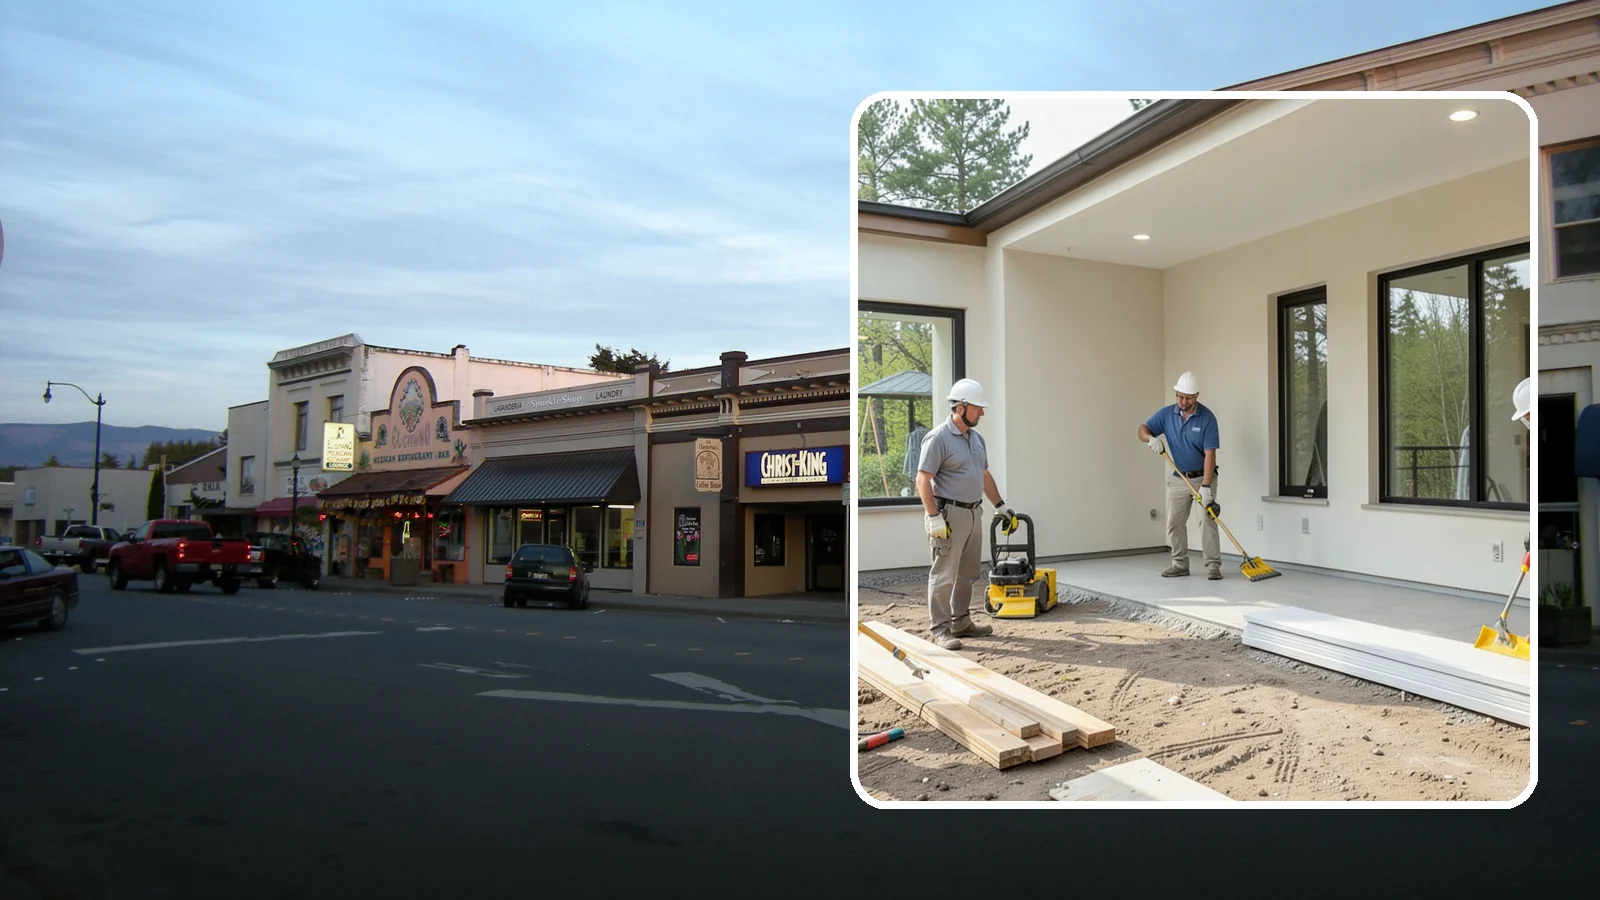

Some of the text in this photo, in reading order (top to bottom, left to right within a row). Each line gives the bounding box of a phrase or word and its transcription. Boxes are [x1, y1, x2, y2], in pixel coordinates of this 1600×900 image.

[595, 389, 624, 400] LAUNDRY
[530, 394, 582, 409] Sparkle Shop
[493, 402, 522, 413] LAVANDERIA
[327, 449, 352, 457] MEXICAN
[373, 454, 396, 464] MEXICAN
[397, 451, 433, 462] RESTAURANT
[437, 450, 450, 459] BAR
[761, 450, 827, 477] CHRIST KING
[697, 480, 709, 489] Coffee
